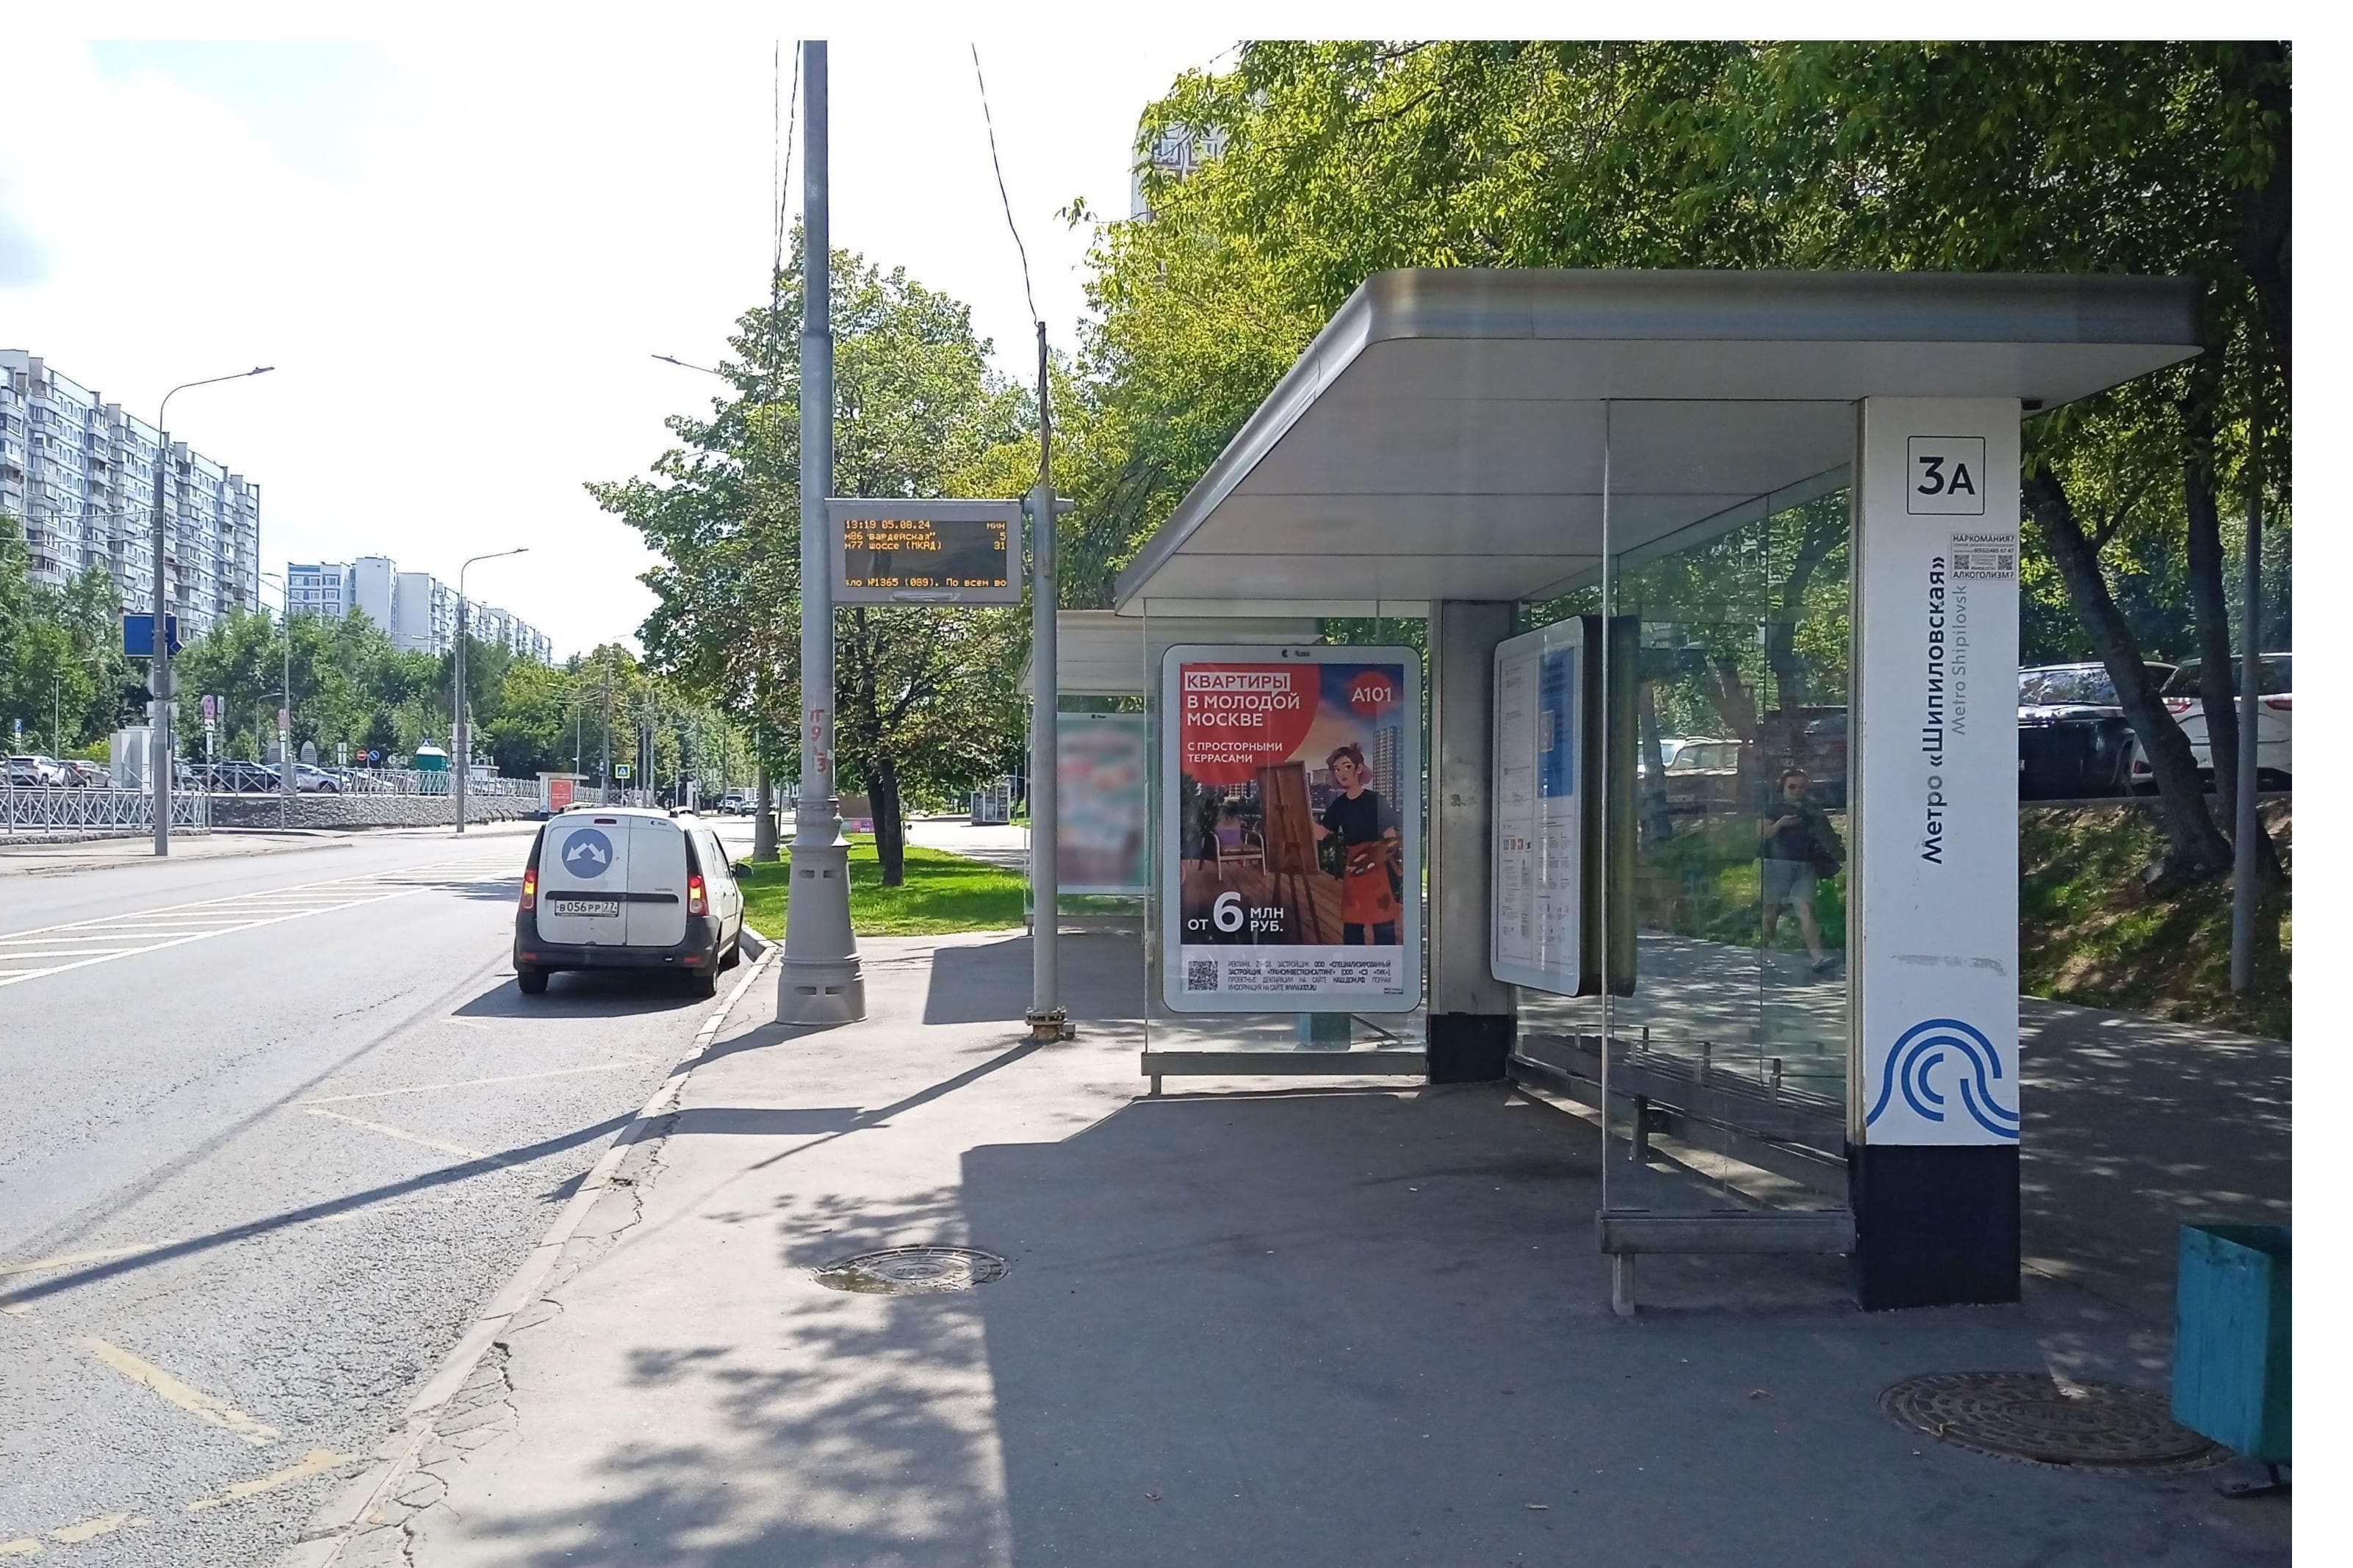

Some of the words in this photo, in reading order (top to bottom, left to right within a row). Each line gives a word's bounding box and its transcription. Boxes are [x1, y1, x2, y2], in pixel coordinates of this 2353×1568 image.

[846, 520, 876, 529] 13:19
[882, 520, 931, 529] 05.08.24
[1000, 532, 1006, 541] 5
[1953, 535, 2015, 543] НАРКОМАНИЯ?
[906, 541, 942, 551] (МКАД)
[993, 541, 1006, 550] 31
[1953, 571, 2014, 579] АЛКОГОЛИЗМ?
[946, 578, 959, 587] По
[964, 579, 989, 587] всем
[994, 579, 1007, 587] во
[1922, 556, 1946, 767] «Шипиловская»
[1187, 675, 1288, 689] КВАРТИРЫ
[1187, 696, 1198, 709] В
[1204, 693, 1300, 711] МОЛОДОЙ
[1952, 682, 1967, 734] Metro
[1187, 713, 1264, 726] МОСКВЕ
[1187, 742, 1195, 751] С
[1197, 742, 1283, 751] ПРОСТОРНЫМИ
[1188, 754, 1253, 763] ТЕРРАСАМИ
[1920, 776, 1947, 864] Метро
[1187, 919, 1208, 931] ОТ
[1213, 891, 1244, 933] 6
[1250, 907, 1284, 919] МЛН
[1250, 920, 1284, 933] РУБ.
